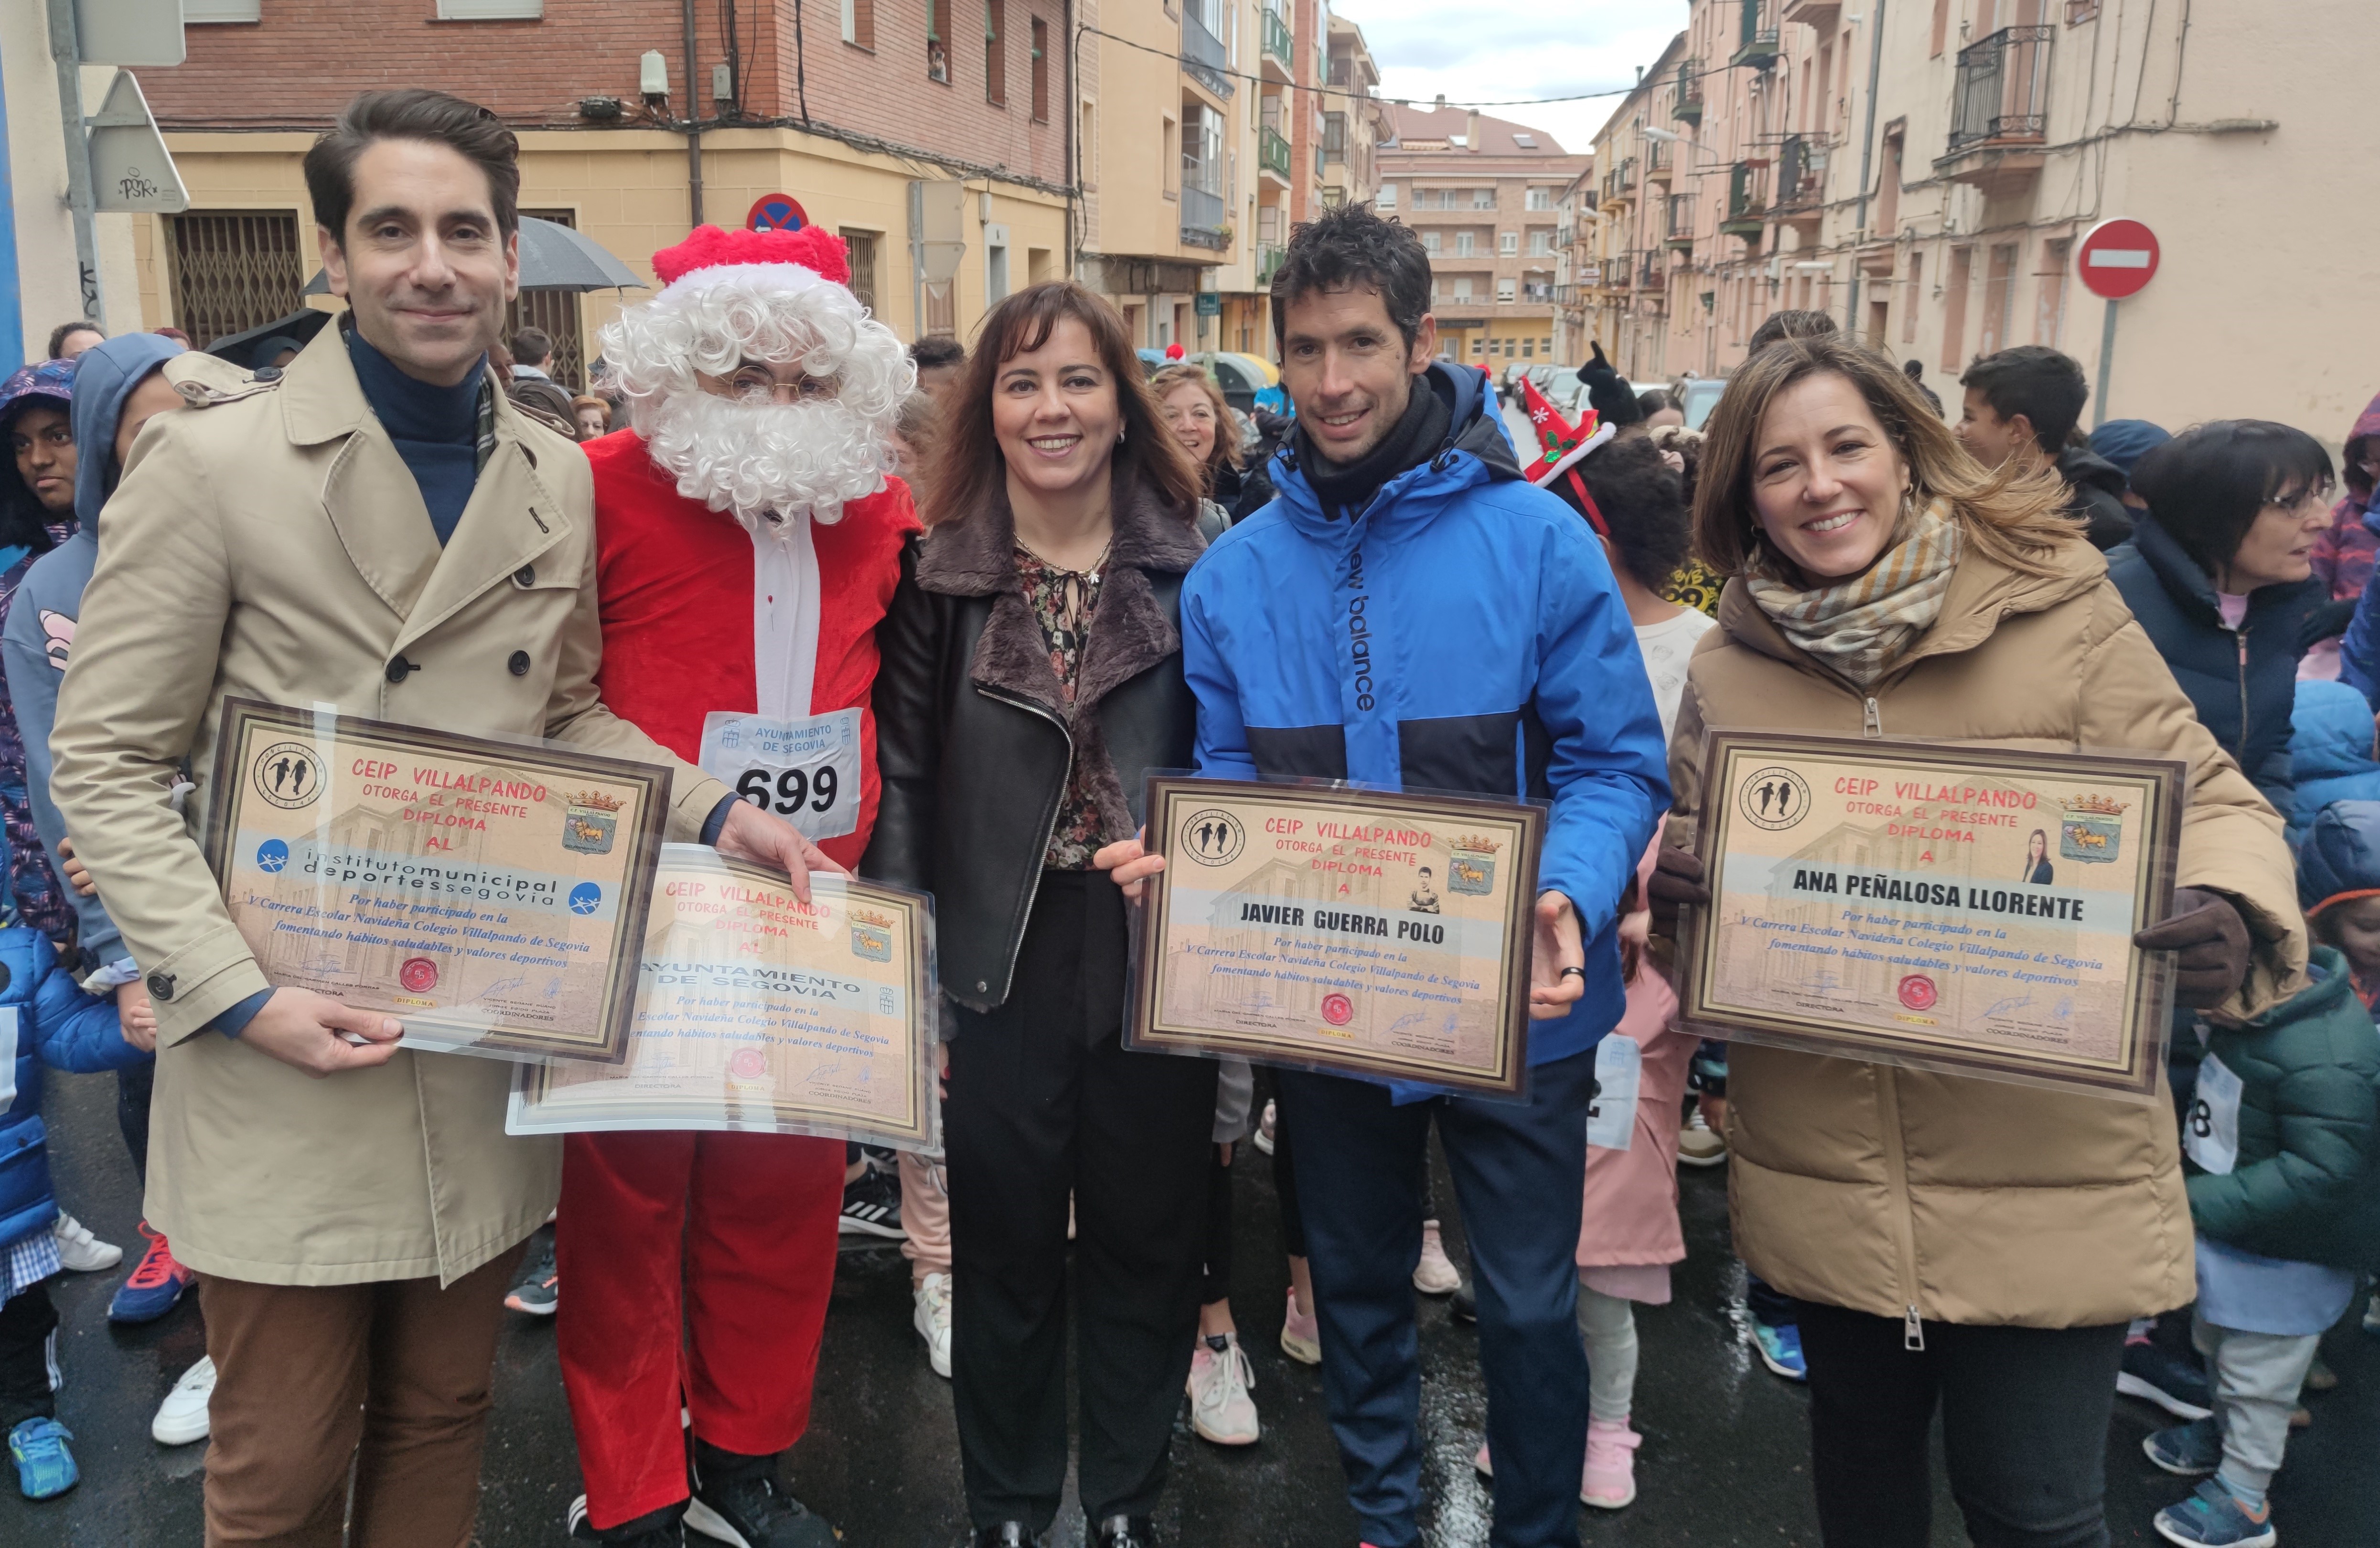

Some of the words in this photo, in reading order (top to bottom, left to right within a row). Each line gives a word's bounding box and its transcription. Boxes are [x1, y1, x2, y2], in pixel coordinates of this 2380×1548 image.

[1348, 540, 1363, 589] ew
[1349, 595, 1374, 711] balance
[755, 724, 831, 741] AYUNTAMIENTO
[763, 741, 779, 752] DE
[783, 739, 825, 753] SEGOVIA
[351, 757, 398, 781] CEIP
[412, 765, 547, 804] VILLALPANDO
[736, 765, 837, 815] 699
[1833, 776, 1879, 797] CEIP
[1894, 780, 2037, 811] VILLALPANDO
[362, 783, 418, 803] OTORGA
[429, 793, 446, 806] EL
[455, 796, 528, 819] PRESENTE
[1846, 801, 1902, 817] OTORGA
[1912, 806, 1930, 820] EL
[1940, 808, 2018, 828] PRESENTE
[403, 808, 487, 832] DIPLOMA
[1265, 816, 1303, 836] CEIP
[1317, 819, 1432, 849] VILLALPANDO
[1887, 823, 1975, 843] DIPLOMA
[426, 835, 455, 851] AL
[1276, 838, 1323, 854] OTORGA
[1332, 844, 1346, 856] EL
[1354, 846, 1417, 864] PRESENTE
[1919, 850, 1935, 862] A
[1312, 858, 1383, 878] DIPLOMA
[666, 882, 706, 896] CEIP
[720, 885, 831, 918] VILLALPANDO
[1338, 882, 1351, 894] A
[1792, 869, 1839, 894] ANA
[1845, 871, 1962, 908] PEÑALOSA
[1968, 887, 2084, 922] LLORENTE
[349, 893, 372, 906] Por
[374, 897, 407, 911] haber
[409, 902, 477, 923] participado
[479, 913, 493, 922] en
[496, 913, 508, 924] la
[677, 902, 727, 914] OTORGA
[737, 907, 750, 917] EL
[760, 909, 819, 929] PRESENTE
[1241, 901, 1305, 928] JAVIER
[1313, 909, 1389, 937] GUERRA
[1397, 920, 1445, 944] POLO
[249, 896, 258, 905] V
[260, 898, 303, 914] Carrera
[305, 906, 351, 921] Escolar
[354, 912, 410, 929] Navideña
[413, 920, 458, 937] Colegio
[461, 926, 527, 946] Villalpando
[529, 935, 544, 946] de
[545, 937, 590, 955] Segovia
[717, 919, 788, 938] DIPLOMA
[1841, 910, 1864, 922] Por
[1866, 913, 1899, 927] haber
[1902, 917, 1973, 938] participado
[1976, 929, 1990, 937] en
[1994, 928, 2007, 939] la
[273, 920, 343, 939] fomentando
[346, 930, 388, 945] hábitos
[391, 936, 453, 954] saludables
[453, 946, 463, 957] y
[465, 946, 507, 960] valores
[509, 951, 568, 970] deportivos
[739, 942, 764, 954] AL
[1274, 936, 1292, 947] Por
[1294, 939, 1322, 951] haber
[1324, 943, 1381, 961] participado
[1398, 953, 1407, 962] la
[1741, 916, 1750, 926] V
[1752, 917, 1796, 932] Carrera
[1799, 923, 1844, 938] Escolar
[1847, 928, 1904, 946] Navideña
[1907, 935, 1954, 954] Colegio
[1958, 942, 2029, 963] Villalpando
[2033, 952, 2048, 964] de
[2052, 953, 2103, 972] Segovia
[1186, 944, 1194, 954] V
[1197, 945, 1235, 958] Carrera
[1238, 948, 1276, 962] Escolar
[1279, 953, 1326, 968] Navideña
[1329, 959, 1366, 975] Colegio
[1369, 965, 1425, 983] Villalpando
[1427, 973, 1439, 984] de
[1441, 976, 1480, 991] Segovia
[1767, 937, 1838, 958] fomentando
[1842, 946, 1883, 961] hábitos
[1887, 952, 1951, 970] saludables
[1951, 964, 1962, 974] y
[1964, 963, 2009, 978] valores
[2012, 969, 2079, 989] deportivos
[641, 963, 861, 993] AYUNTAMIENTO
[658, 975, 697, 984] DE
[711, 977, 837, 1000] SEGOVIA
[1210, 962, 1271, 981] fomentando
[1275, 969, 1309, 982] hábitos
[1312, 974, 1364, 989] saludables
[1364, 984, 1372, 993] y
[1374, 983, 1409, 996] valores
[1411, 989, 1462, 1006] deportivos
[397, 997, 434, 1007] DIPLOMA
[481, 1007, 554, 1021] COORDINADORES
[676, 996, 696, 1005] Por
[700, 997, 730, 1006] haber
[732, 999, 791, 1013] participado
[809, 1007, 818, 1016] la
[1796, 1001, 1844, 1013] DIRECTORA
[638, 1011, 679, 1021] Escolar
[683, 1012, 733, 1023] Navideña
[737, 1014, 776, 1028] Colegio
[782, 1019, 836, 1035] Villalpando
[840, 1028, 850, 1037] de
[854, 1031, 889, 1044] Segovia
[1236, 1019, 1277, 1029] DIRECTORA
[631, 1028, 674, 1037] entando
[677, 1029, 717, 1038] hábitos
[719, 1029, 775, 1043] saludables
[776, 1037, 784, 1045] y
[787, 1036, 822, 1048] valores
[825, 1043, 873, 1057] deportivos
